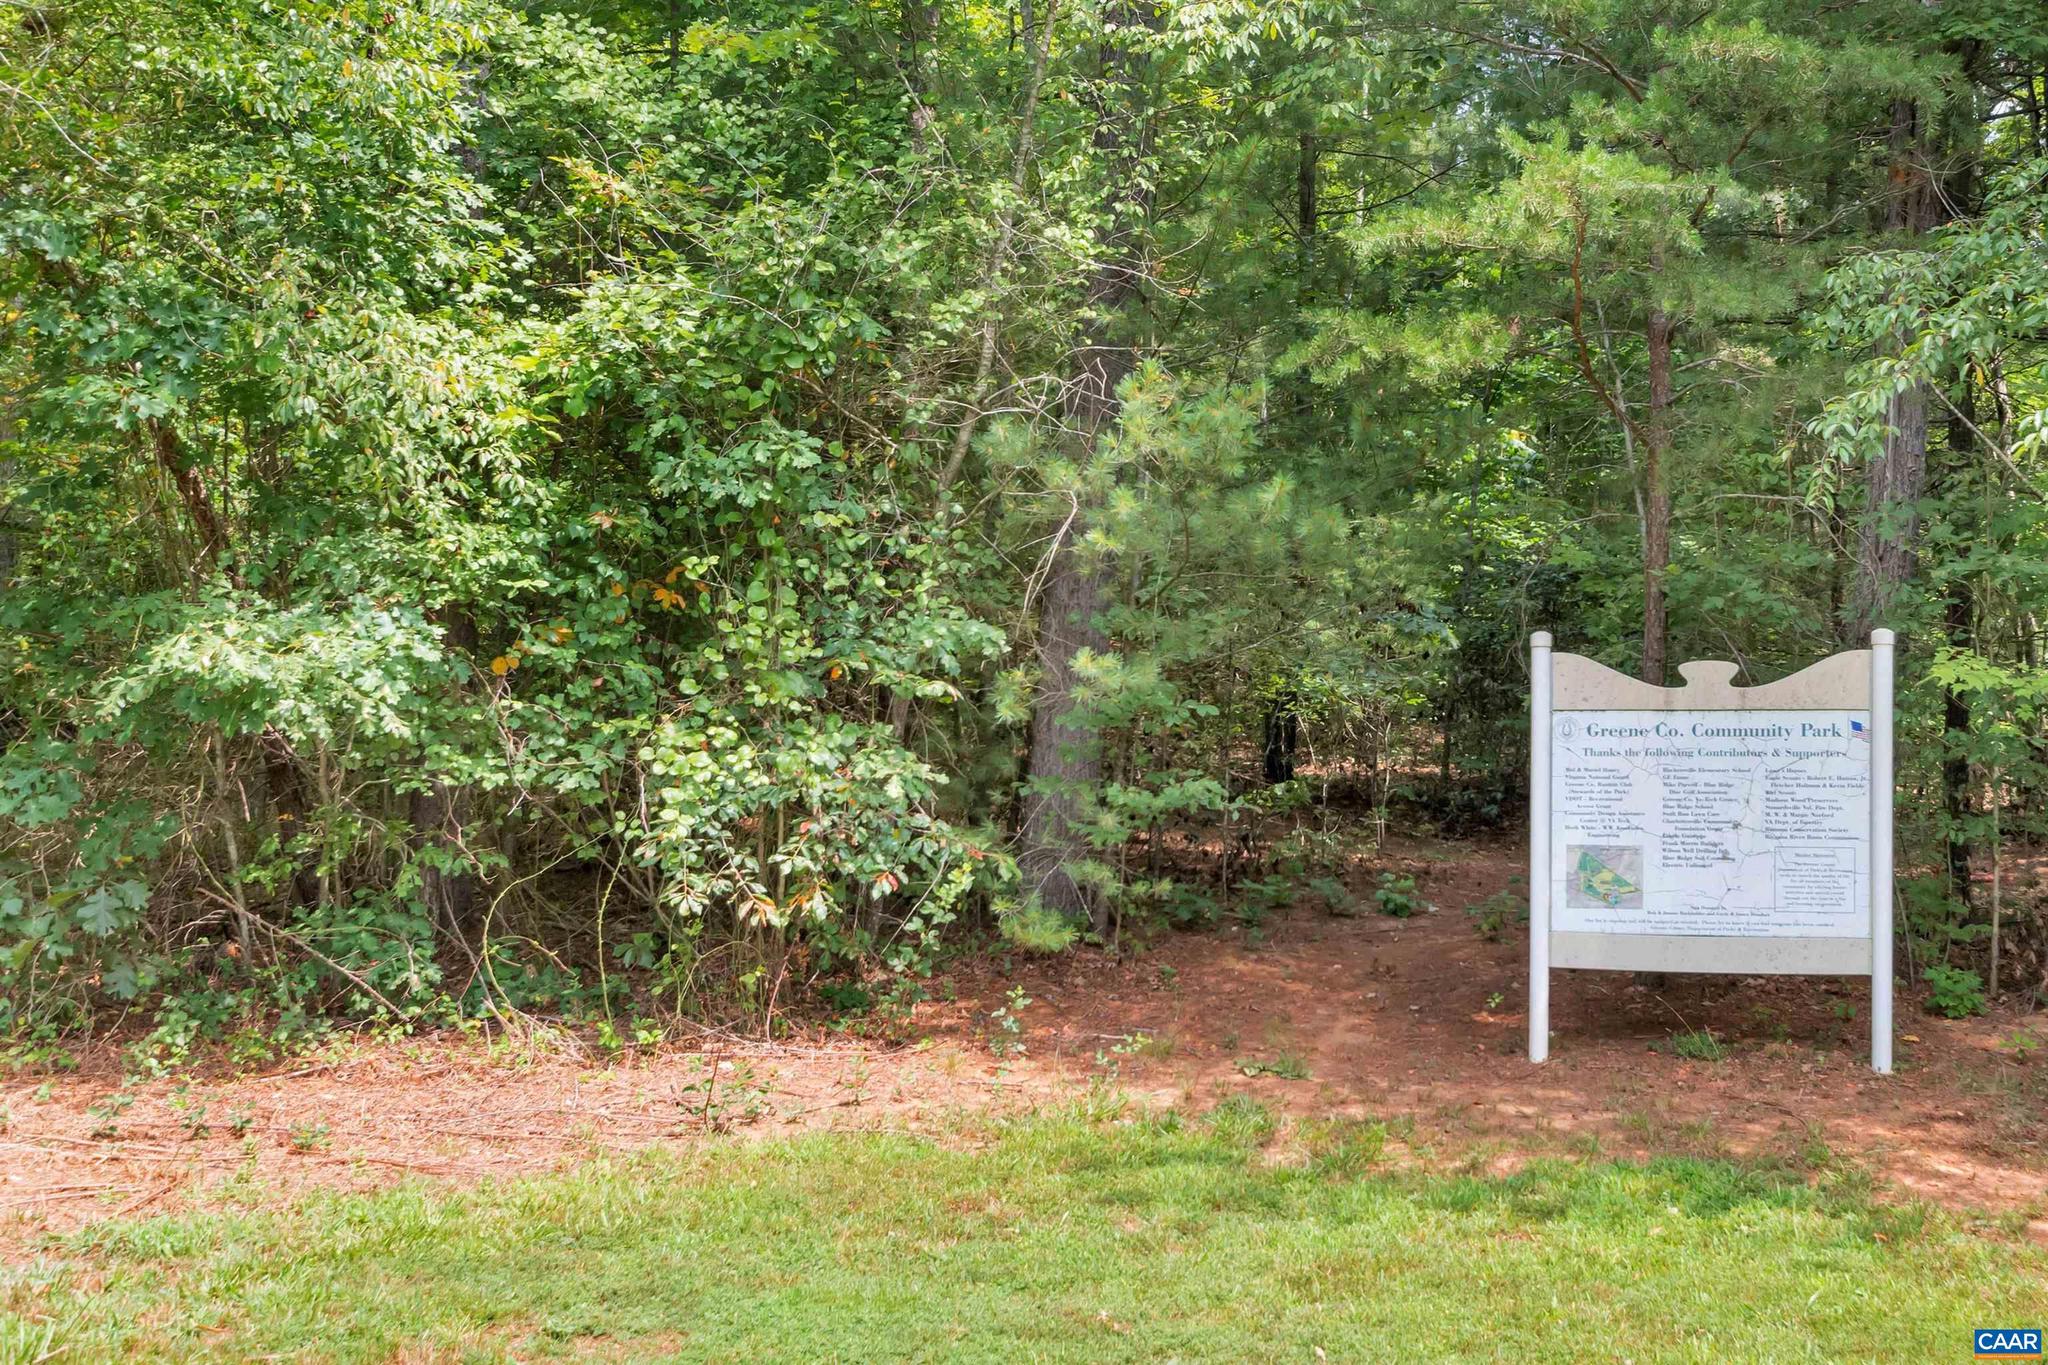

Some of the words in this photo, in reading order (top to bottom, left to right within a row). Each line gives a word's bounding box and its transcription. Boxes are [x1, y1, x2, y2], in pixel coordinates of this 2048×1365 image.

[1586, 722, 1649, 738] Greene
[1655, 722, 1684, 738] Co.
[1691, 722, 1793, 742] Community
[1800, 722, 1842, 738] Park
[1582, 747, 1621, 758] Thanks
[1624, 747, 1642, 758] the
[1644, 747, 1694, 760] following
[1698, 747, 1768, 758] Contributors
[1771, 747, 1781, 758] &
[1784, 748, 1847, 761] Supporters
